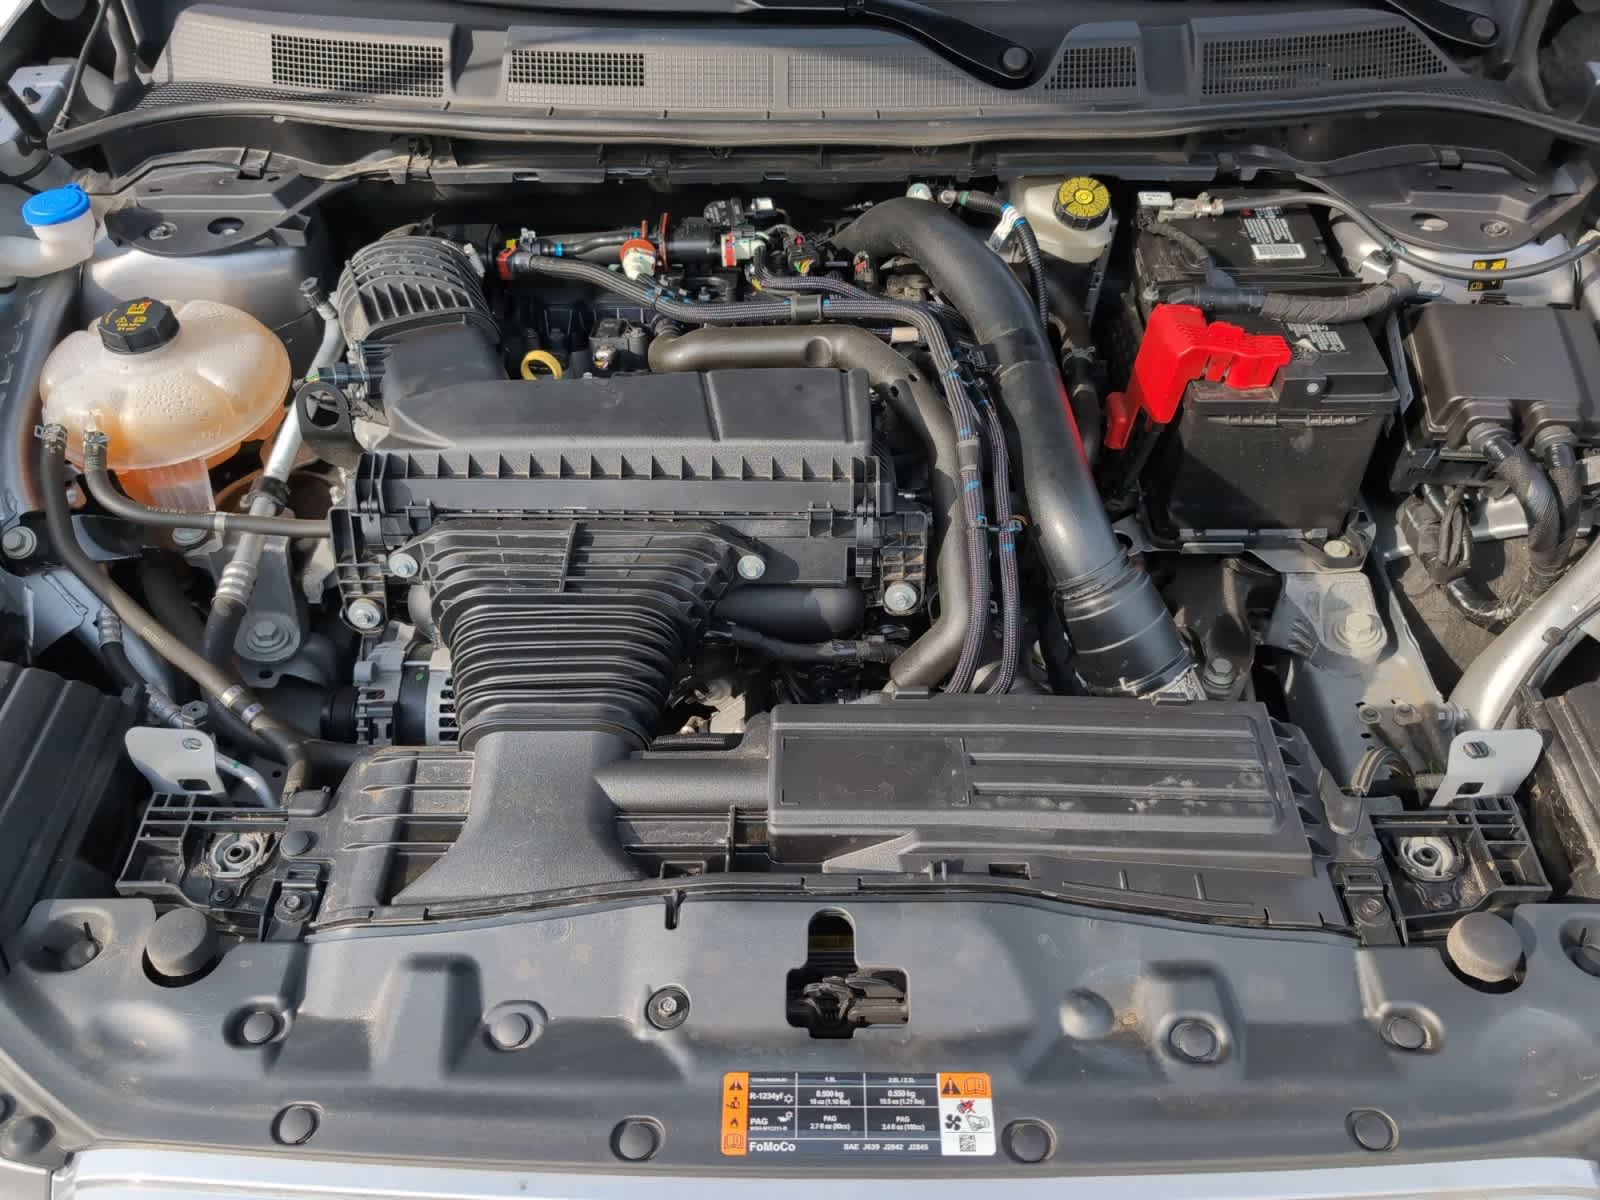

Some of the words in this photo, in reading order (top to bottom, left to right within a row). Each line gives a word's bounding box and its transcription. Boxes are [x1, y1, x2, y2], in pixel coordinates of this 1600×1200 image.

[750, 1092, 784, 1101] R-1234yf
[834, 1090, 844, 1099] kg
[906, 1090, 916, 1099] kg
[750, 1118, 769, 1126] PAG
[750, 1141, 796, 1152] FoMoCo
[843, 1143, 860, 1151] SAE
[862, 1143, 880, 1151] J639
